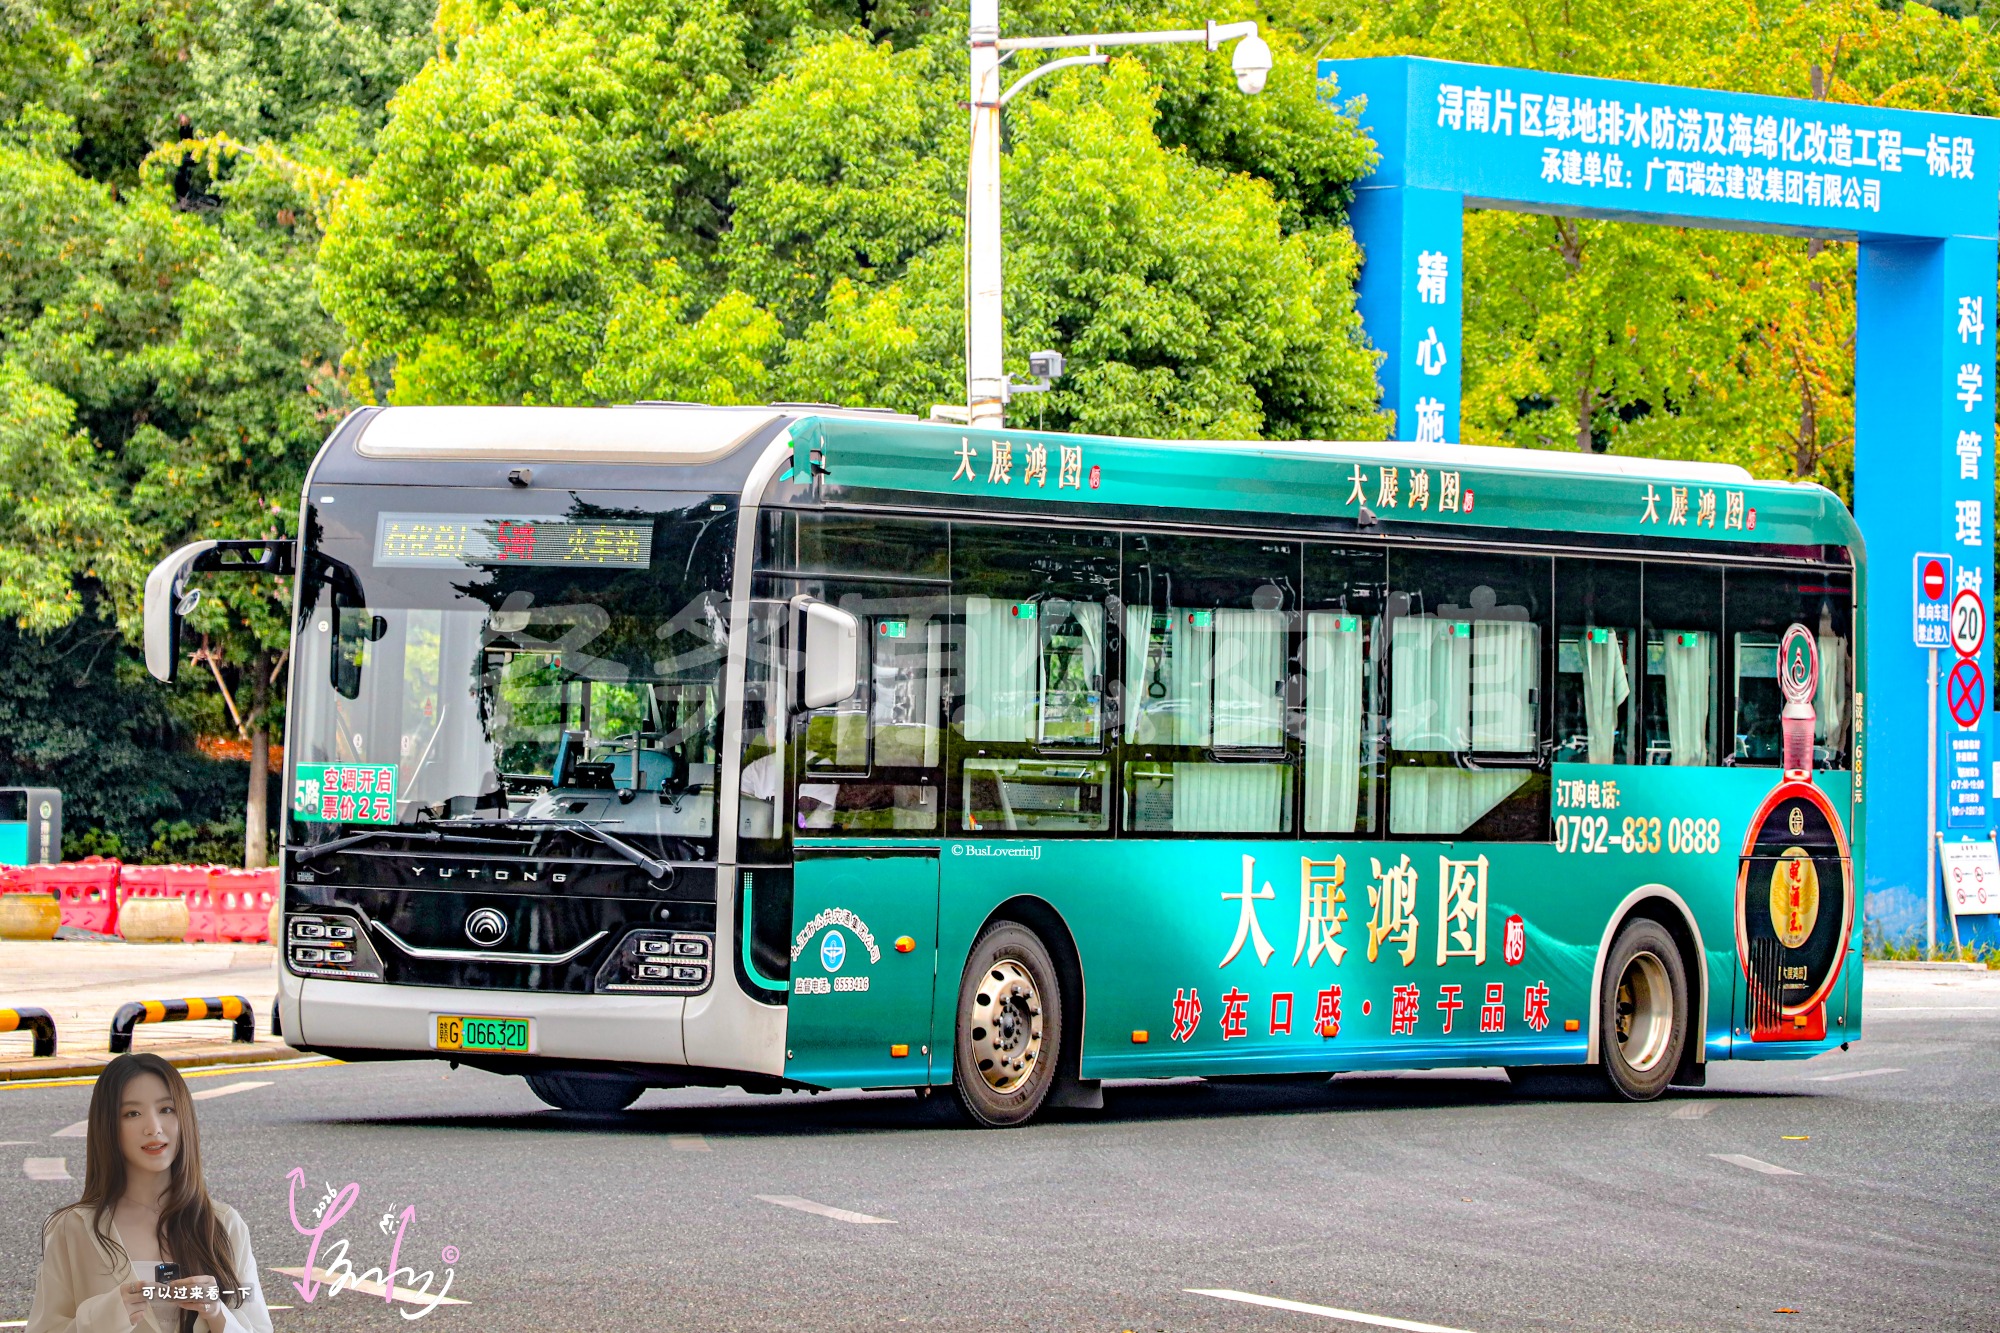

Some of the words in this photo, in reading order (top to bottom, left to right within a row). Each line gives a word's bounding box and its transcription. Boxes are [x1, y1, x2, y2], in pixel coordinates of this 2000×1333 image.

[1437, 83, 1975, 180] 浔南片区绿地排水防涝及海绵化改造工程一标段
[951, 436, 1083, 490] 大展鸿图
[1345, 463, 1461, 514] 大展鸿图
[1639, 484, 1745, 531] 大展鸿图
[563, 525, 641, 562] 火车站
[1958, 606, 1978, 641] 20
[322, 766, 393, 794] 空调开启
[321, 795, 392, 821] 票价2元
[1668, 817, 1721, 855] 0888
[411, 866, 567, 883] YUTONG
[1218, 852, 1490, 969] 大展鸿图
